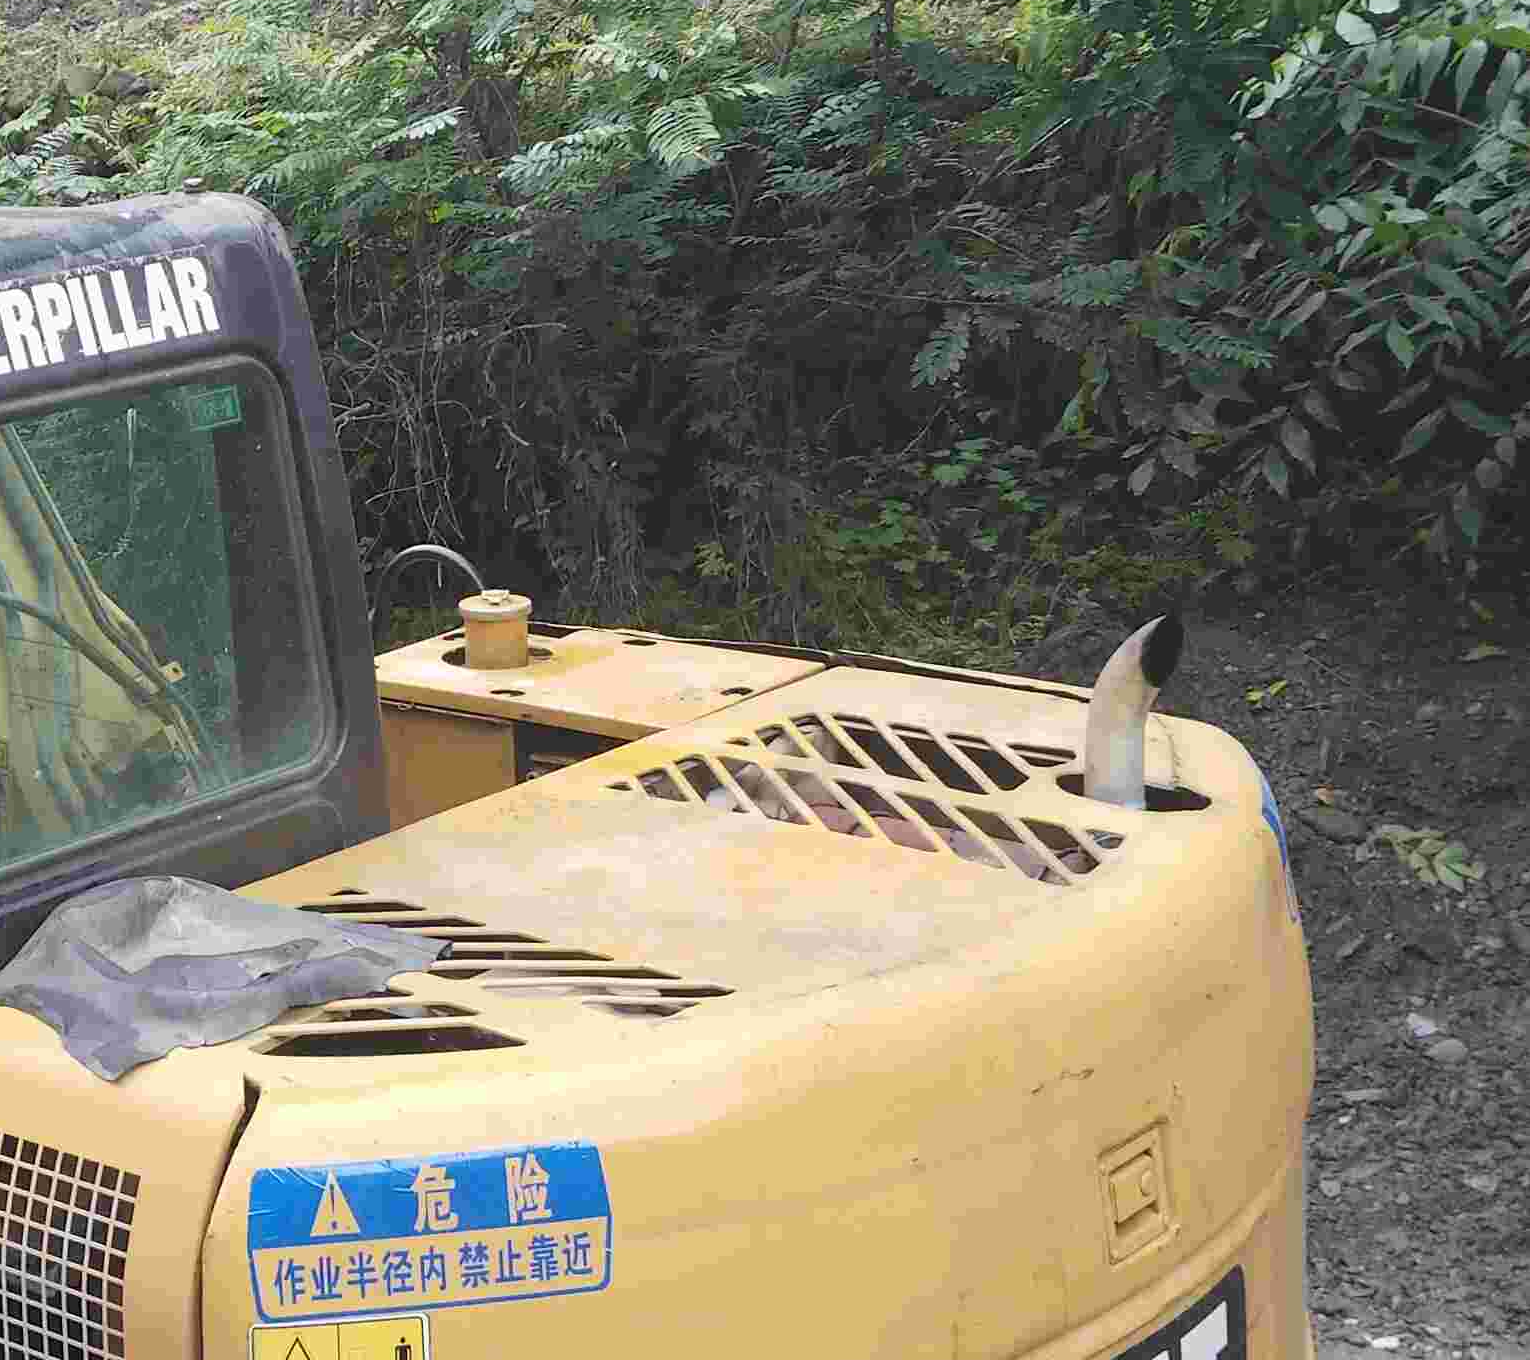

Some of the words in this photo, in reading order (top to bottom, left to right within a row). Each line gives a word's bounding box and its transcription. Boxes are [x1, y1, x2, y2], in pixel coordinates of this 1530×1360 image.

[411, 1153, 552, 1233] 危险
[273, 1233, 593, 1305] 作业半径内禁止靠近
